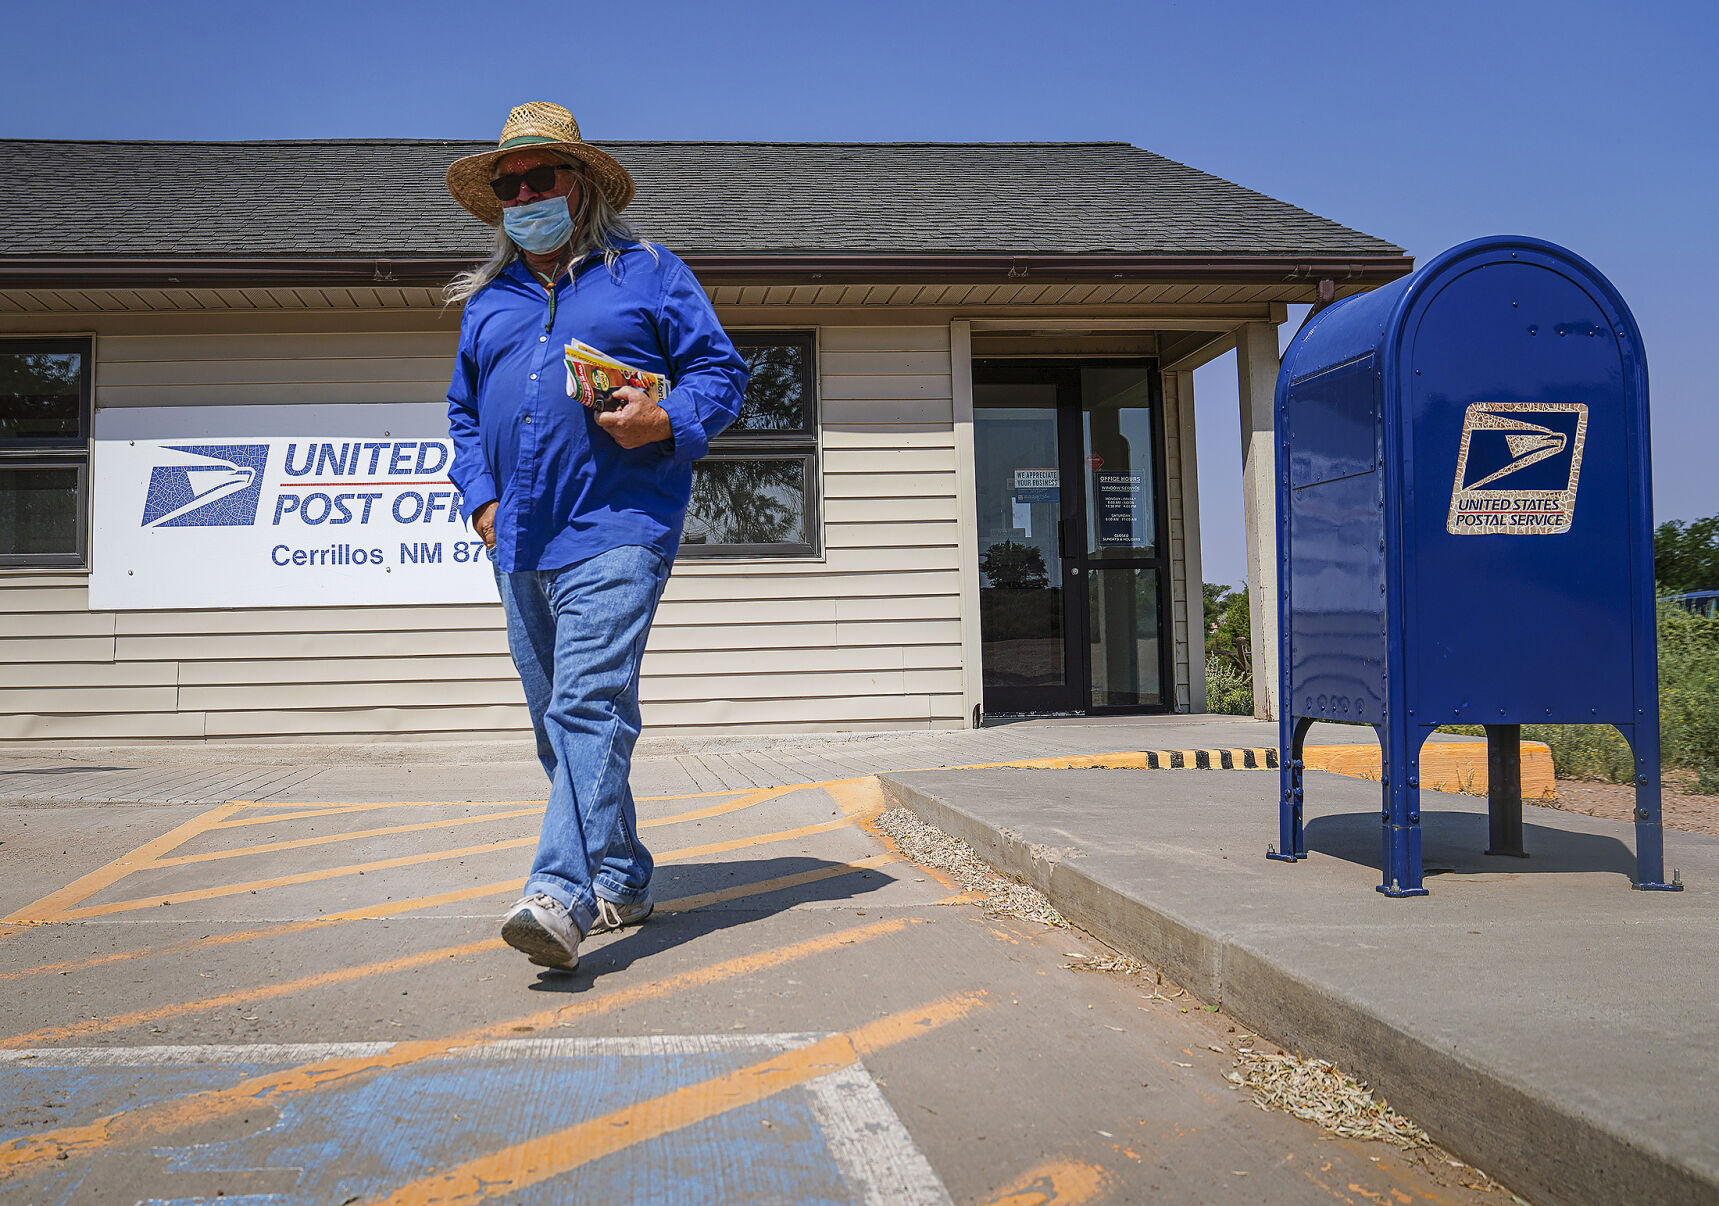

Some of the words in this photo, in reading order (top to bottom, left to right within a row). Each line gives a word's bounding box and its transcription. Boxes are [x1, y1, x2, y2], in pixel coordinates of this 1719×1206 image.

[284, 442, 448, 476] UNITED
[1016, 471, 1025, 479] WE
[1026, 471, 1057, 479] APPRECIATE
[1016, 479, 1032, 487] YOUR
[1032, 479, 1058, 487] BUSINESS
[272, 492, 383, 525] POST
[1458, 499, 1511, 511] UNITED
[1511, 499, 1560, 511] STATES
[1456, 515, 1508, 526] POSTAL
[1510, 515, 1564, 526] SERVICE
[271, 543, 384, 566] Cerrillos
[400, 542, 442, 563] NM
[453, 541, 484, 562] 87
